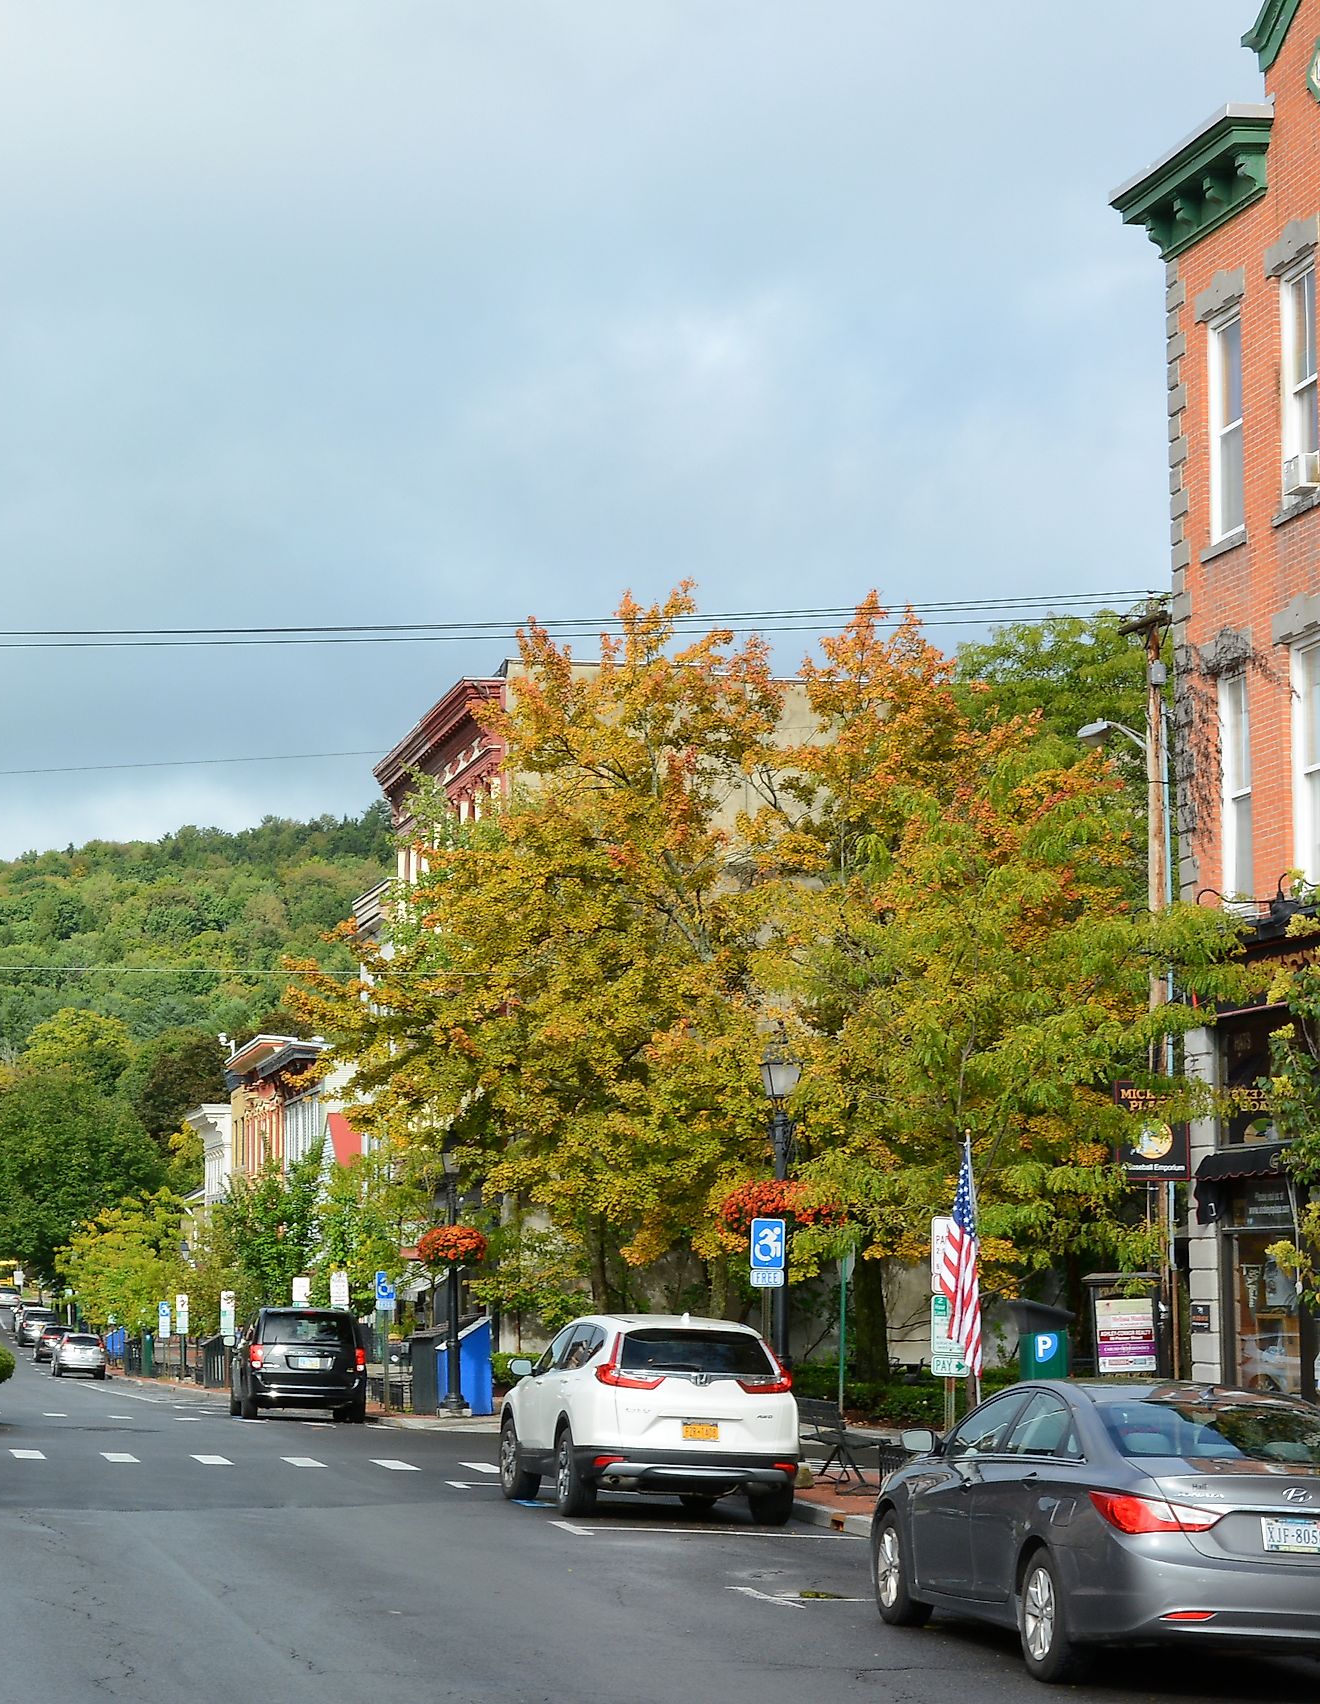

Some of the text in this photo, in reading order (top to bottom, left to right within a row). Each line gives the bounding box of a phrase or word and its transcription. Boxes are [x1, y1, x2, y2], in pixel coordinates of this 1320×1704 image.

[757, 1273, 778, 1283] FREE
[1038, 1336, 1052, 1357] P
[935, 1360, 952, 1371] PAY
[1266, 1526, 1320, 1544] XJF-805
